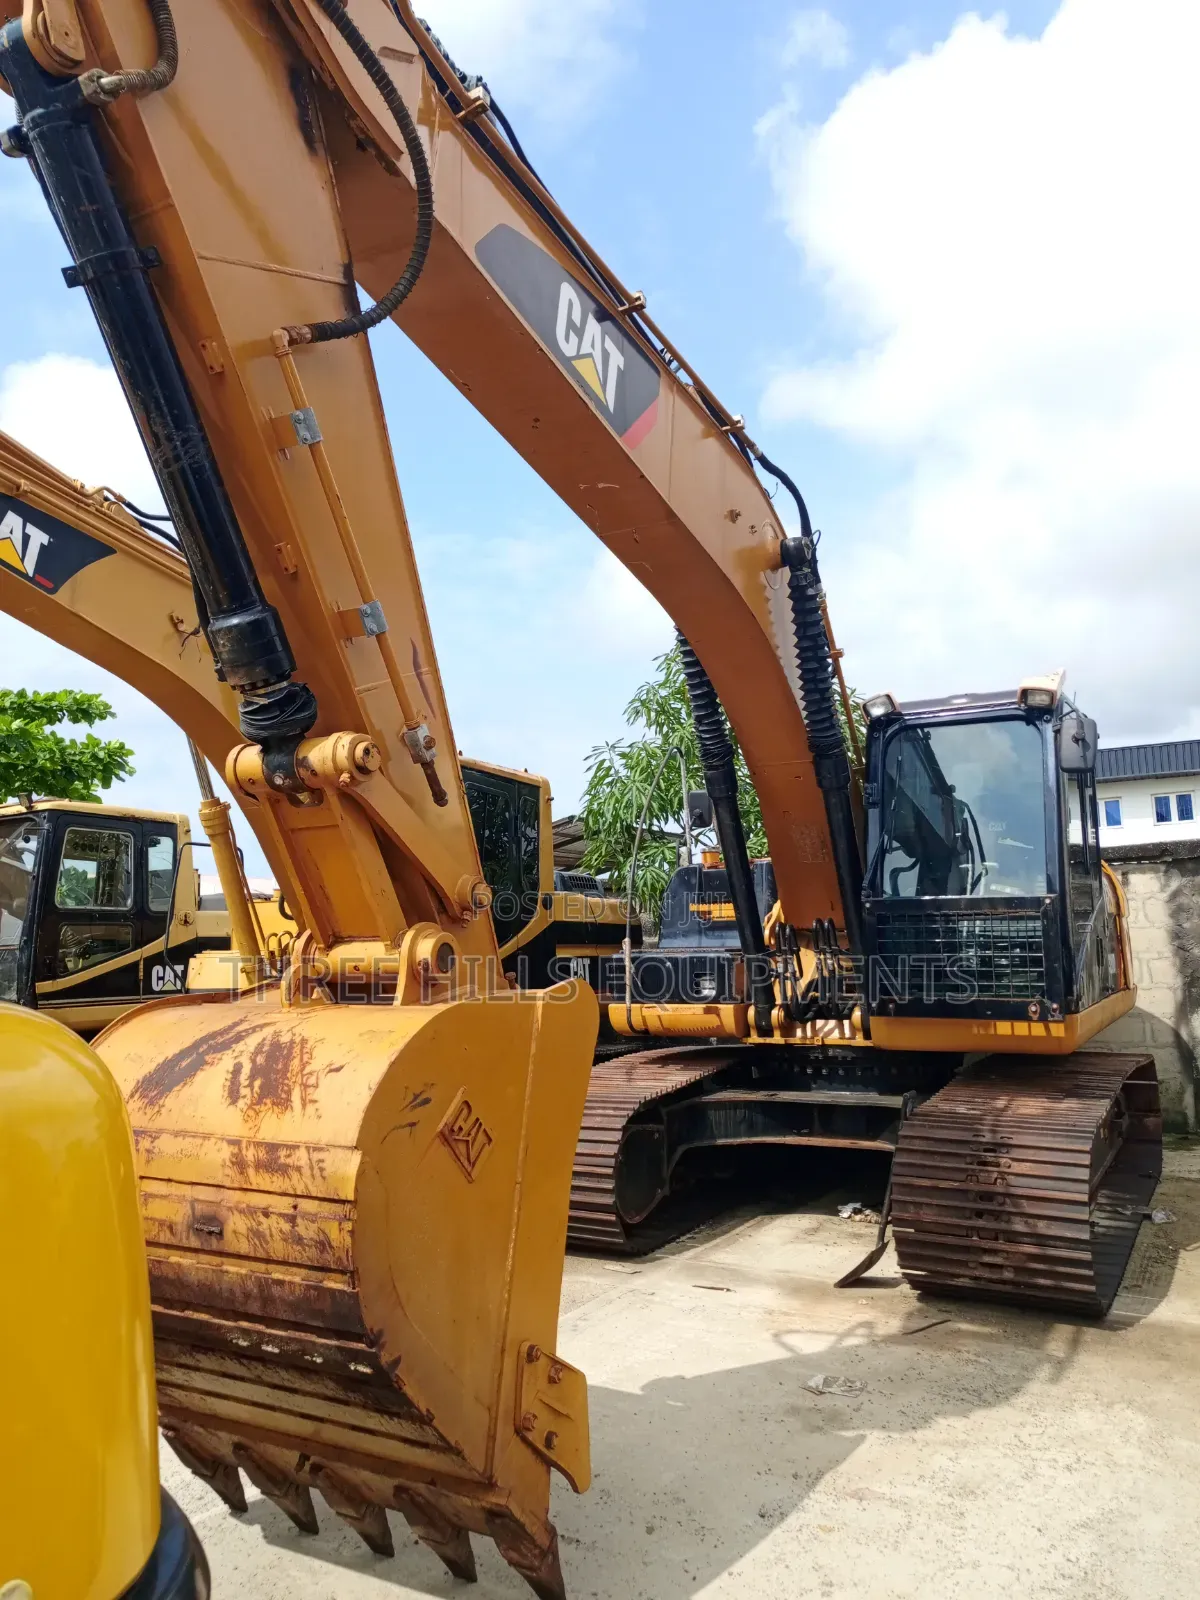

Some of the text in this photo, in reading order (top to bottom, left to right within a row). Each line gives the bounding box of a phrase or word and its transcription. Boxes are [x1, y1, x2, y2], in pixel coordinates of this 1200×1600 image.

[555, 281, 624, 414] CAT
[0, 509, 50, 578] AT
[151, 964, 184, 991] CAT
[570, 957, 590, 985] CAT
